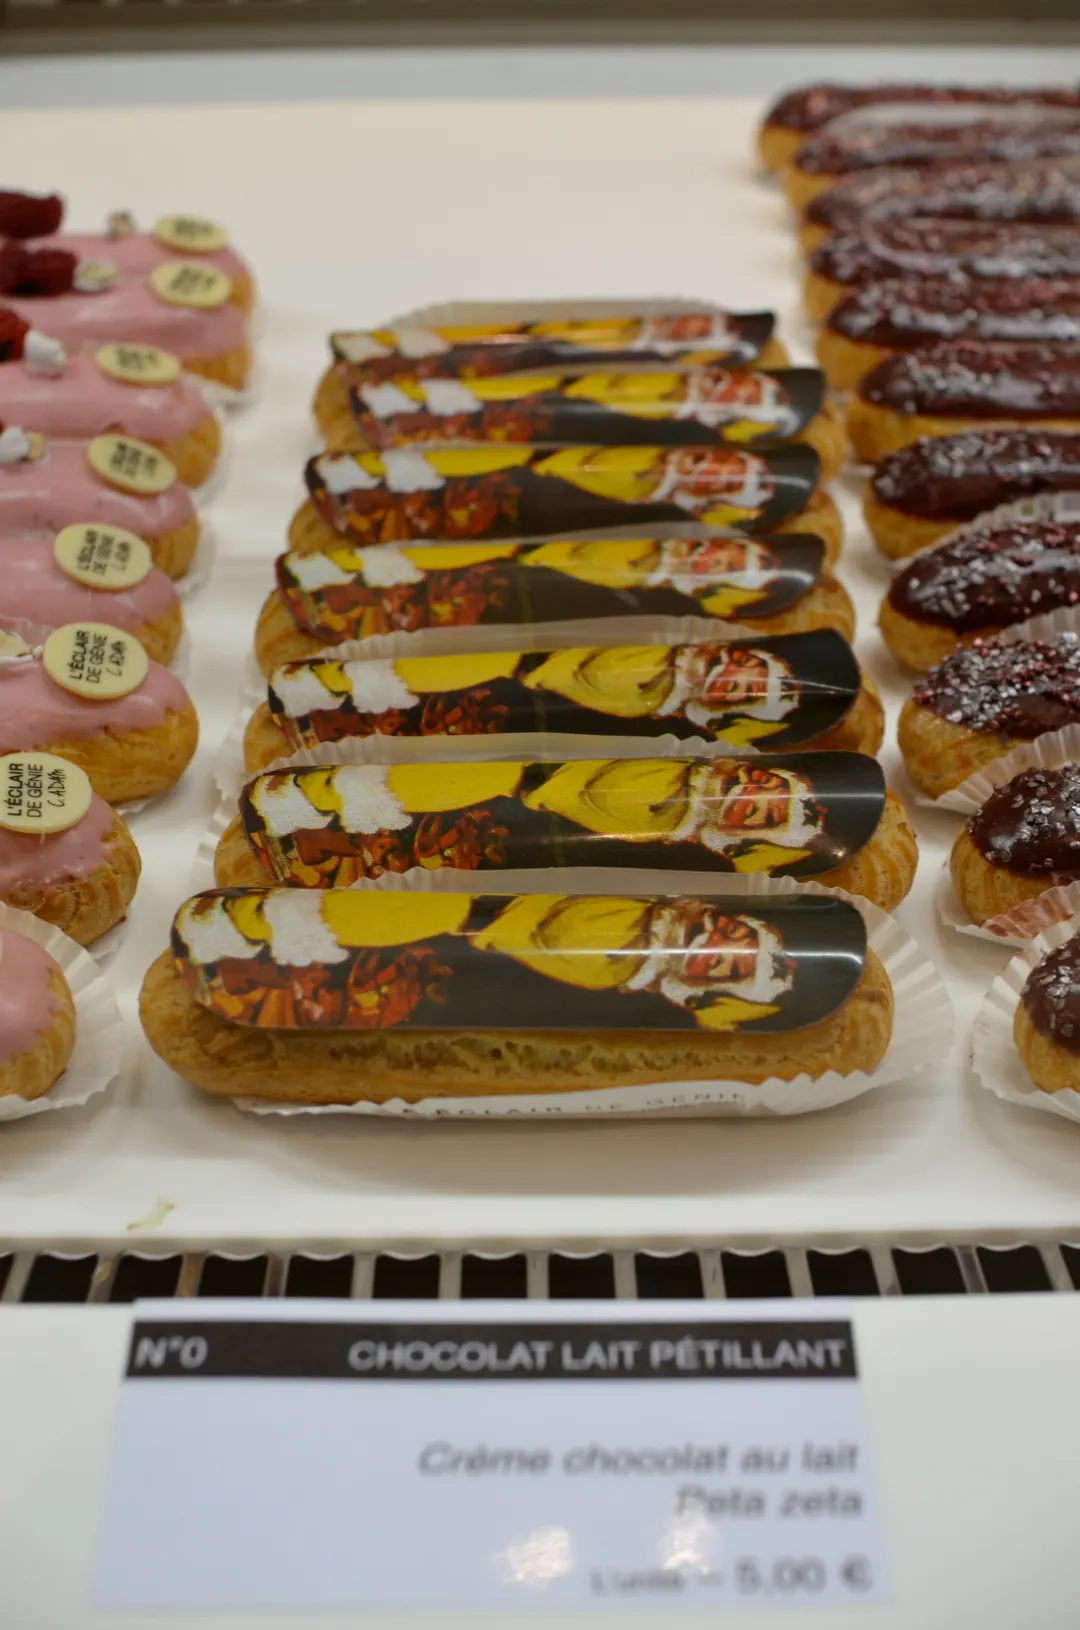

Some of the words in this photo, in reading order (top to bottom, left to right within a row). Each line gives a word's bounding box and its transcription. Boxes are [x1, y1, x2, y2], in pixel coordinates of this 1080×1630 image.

[86, 666, 102, 684] DE
[4, 763, 24, 816] L'ÉCLAIR
[24, 764, 44, 798] GÉNIE
[26, 800, 43, 818] DE
[134, 1335, 208, 1370] N°0
[348, 1339, 554, 1372] CHOCOLAT
[560, 1339, 641, 1371] LAIT
[649, 1334, 847, 1371] PÉTILLANT
[561, 1442, 731, 1477] chocolat
[739, 1446, 791, 1474] au
[801, 1441, 861, 1474] lait
[676, 1483, 767, 1518] Peta
[779, 1487, 865, 1519] zeta
[734, 1555, 828, 1598] 5,00
